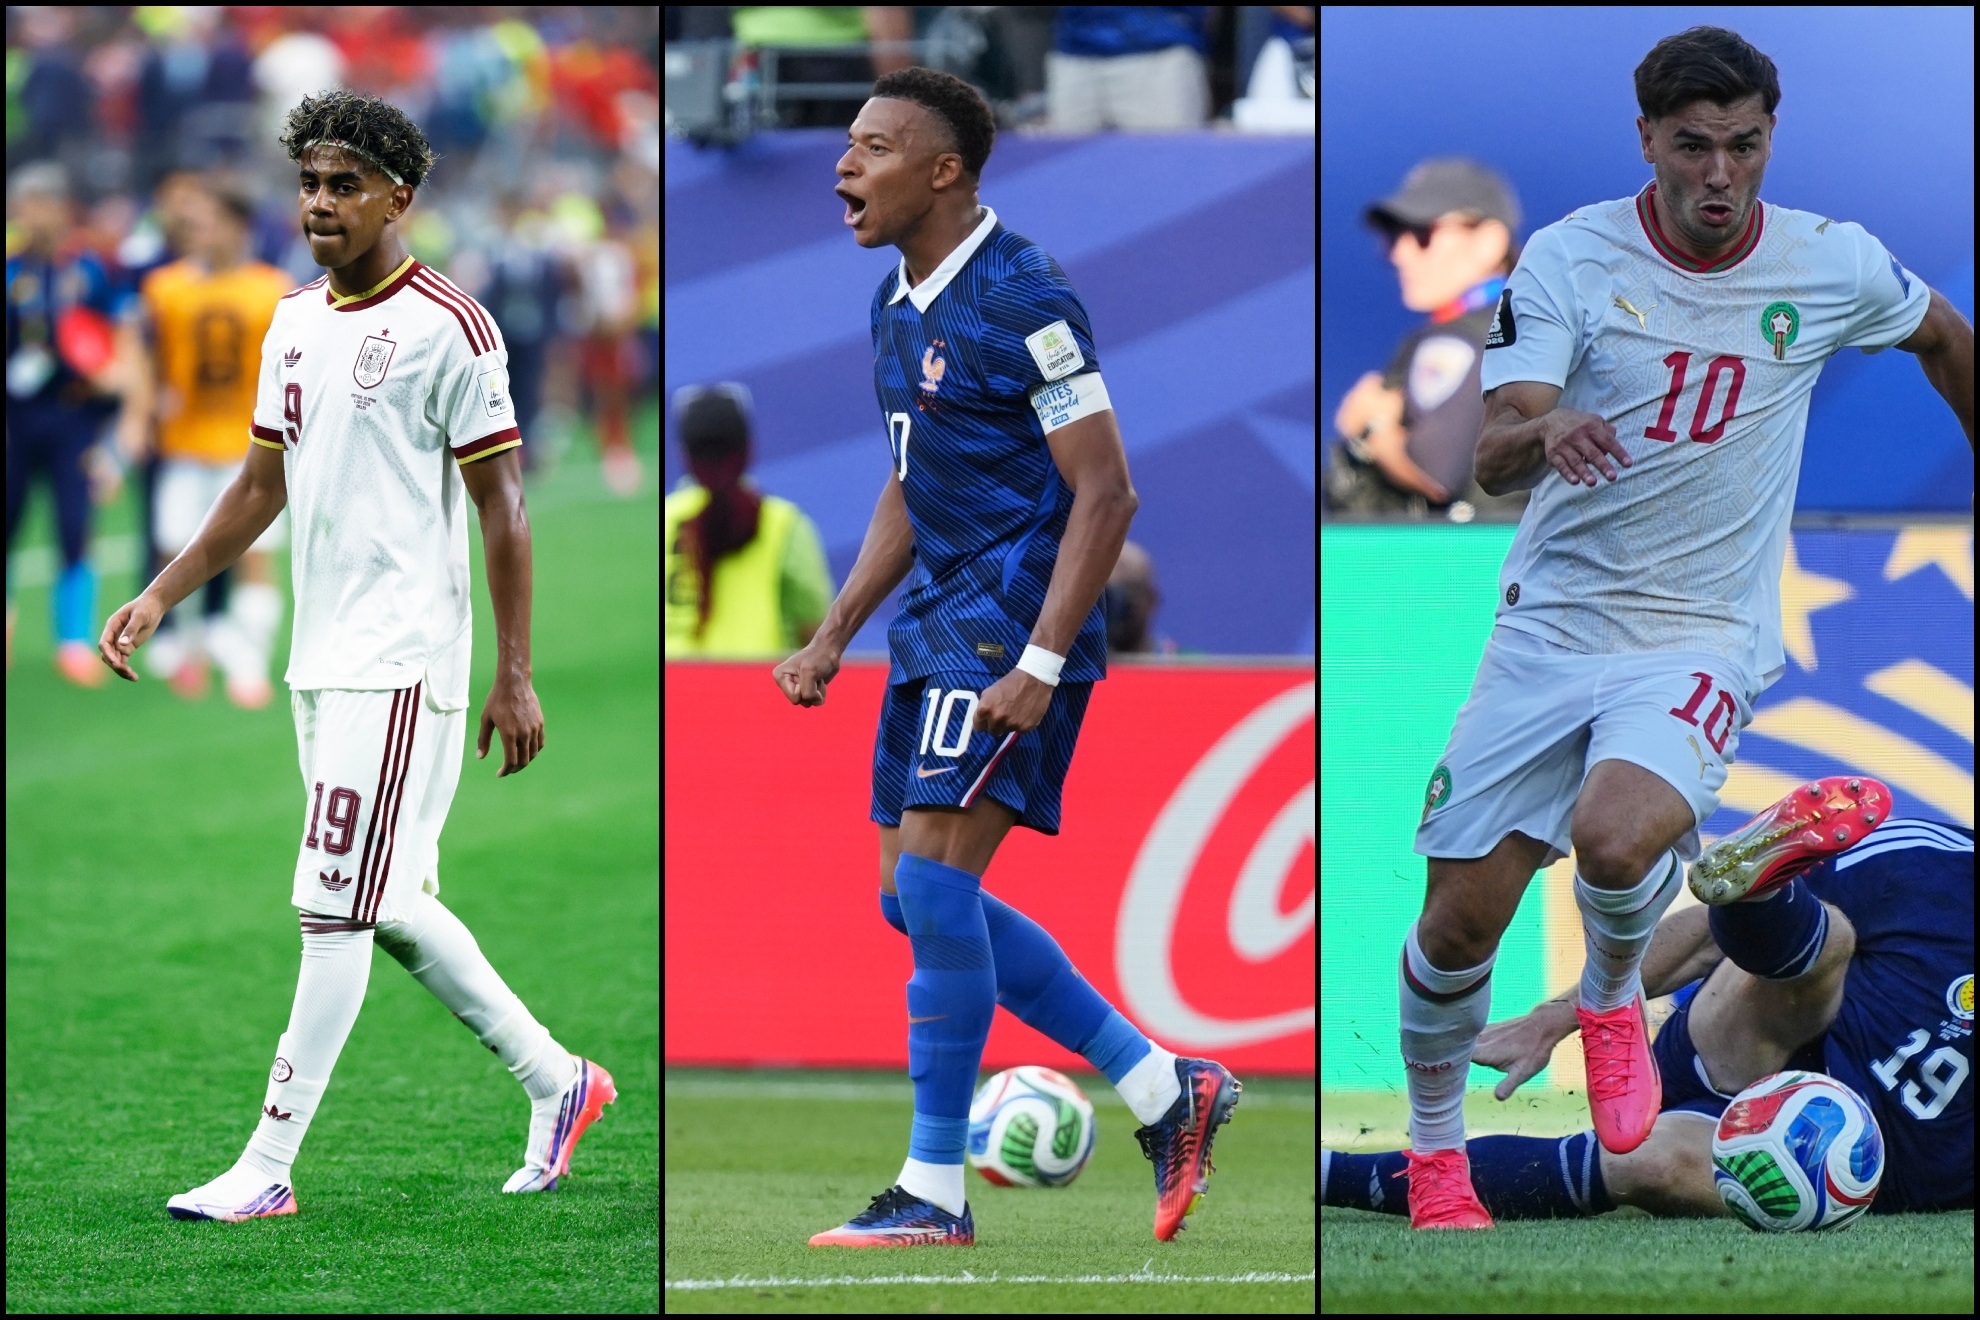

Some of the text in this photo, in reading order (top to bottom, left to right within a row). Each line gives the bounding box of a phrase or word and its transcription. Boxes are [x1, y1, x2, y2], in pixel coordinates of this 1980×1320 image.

[1047, 352, 1075, 370] EDUCATION
[1486, 337, 1504, 345] 026
[284, 383, 302, 451] 9
[1034, 384, 1072, 409] UNITES
[1050, 394, 1079, 415] World
[1644, 351, 1746, 444] 10
[885, 411, 911, 481] 0
[920, 688, 979, 757] 10
[1669, 672, 1735, 754] 10
[305, 781, 362, 856] 19
[1870, 1028, 1970, 1120] 19
